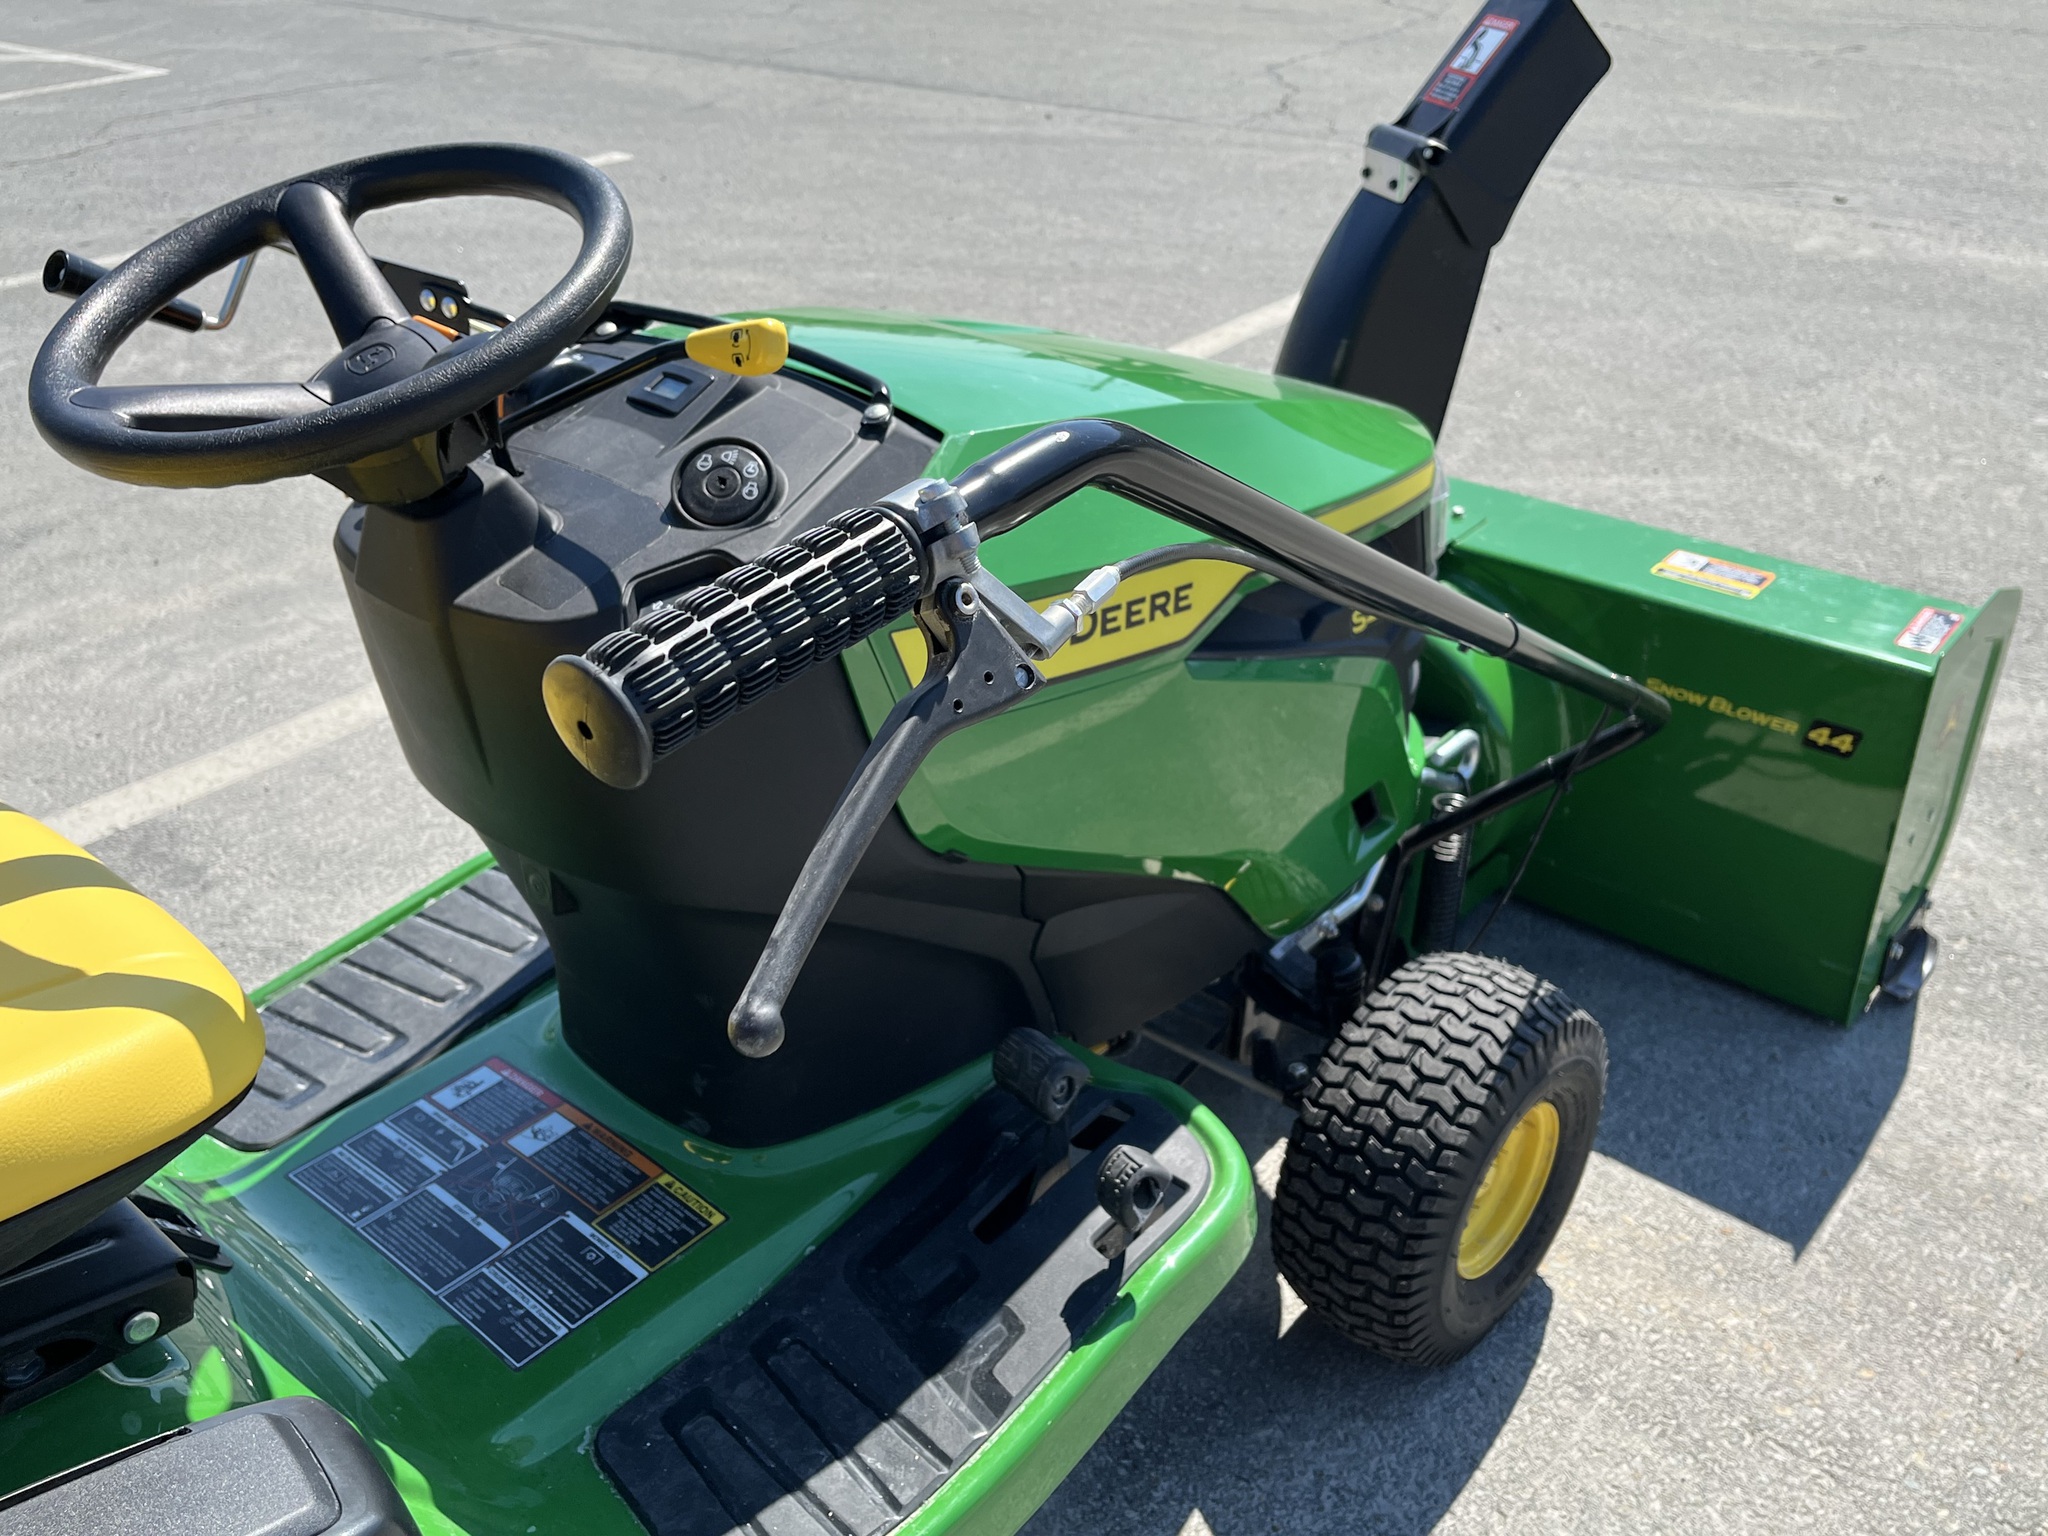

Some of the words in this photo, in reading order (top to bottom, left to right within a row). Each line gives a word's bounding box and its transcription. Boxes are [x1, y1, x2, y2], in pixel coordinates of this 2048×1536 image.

[1070, 582, 1193, 646] DEERE
[1646, 677, 1708, 707] SNOW
[1708, 696, 1799, 736] BLOWER
[1807, 726, 1855, 754] 44
[672, 1184, 717, 1220] CAUTION
